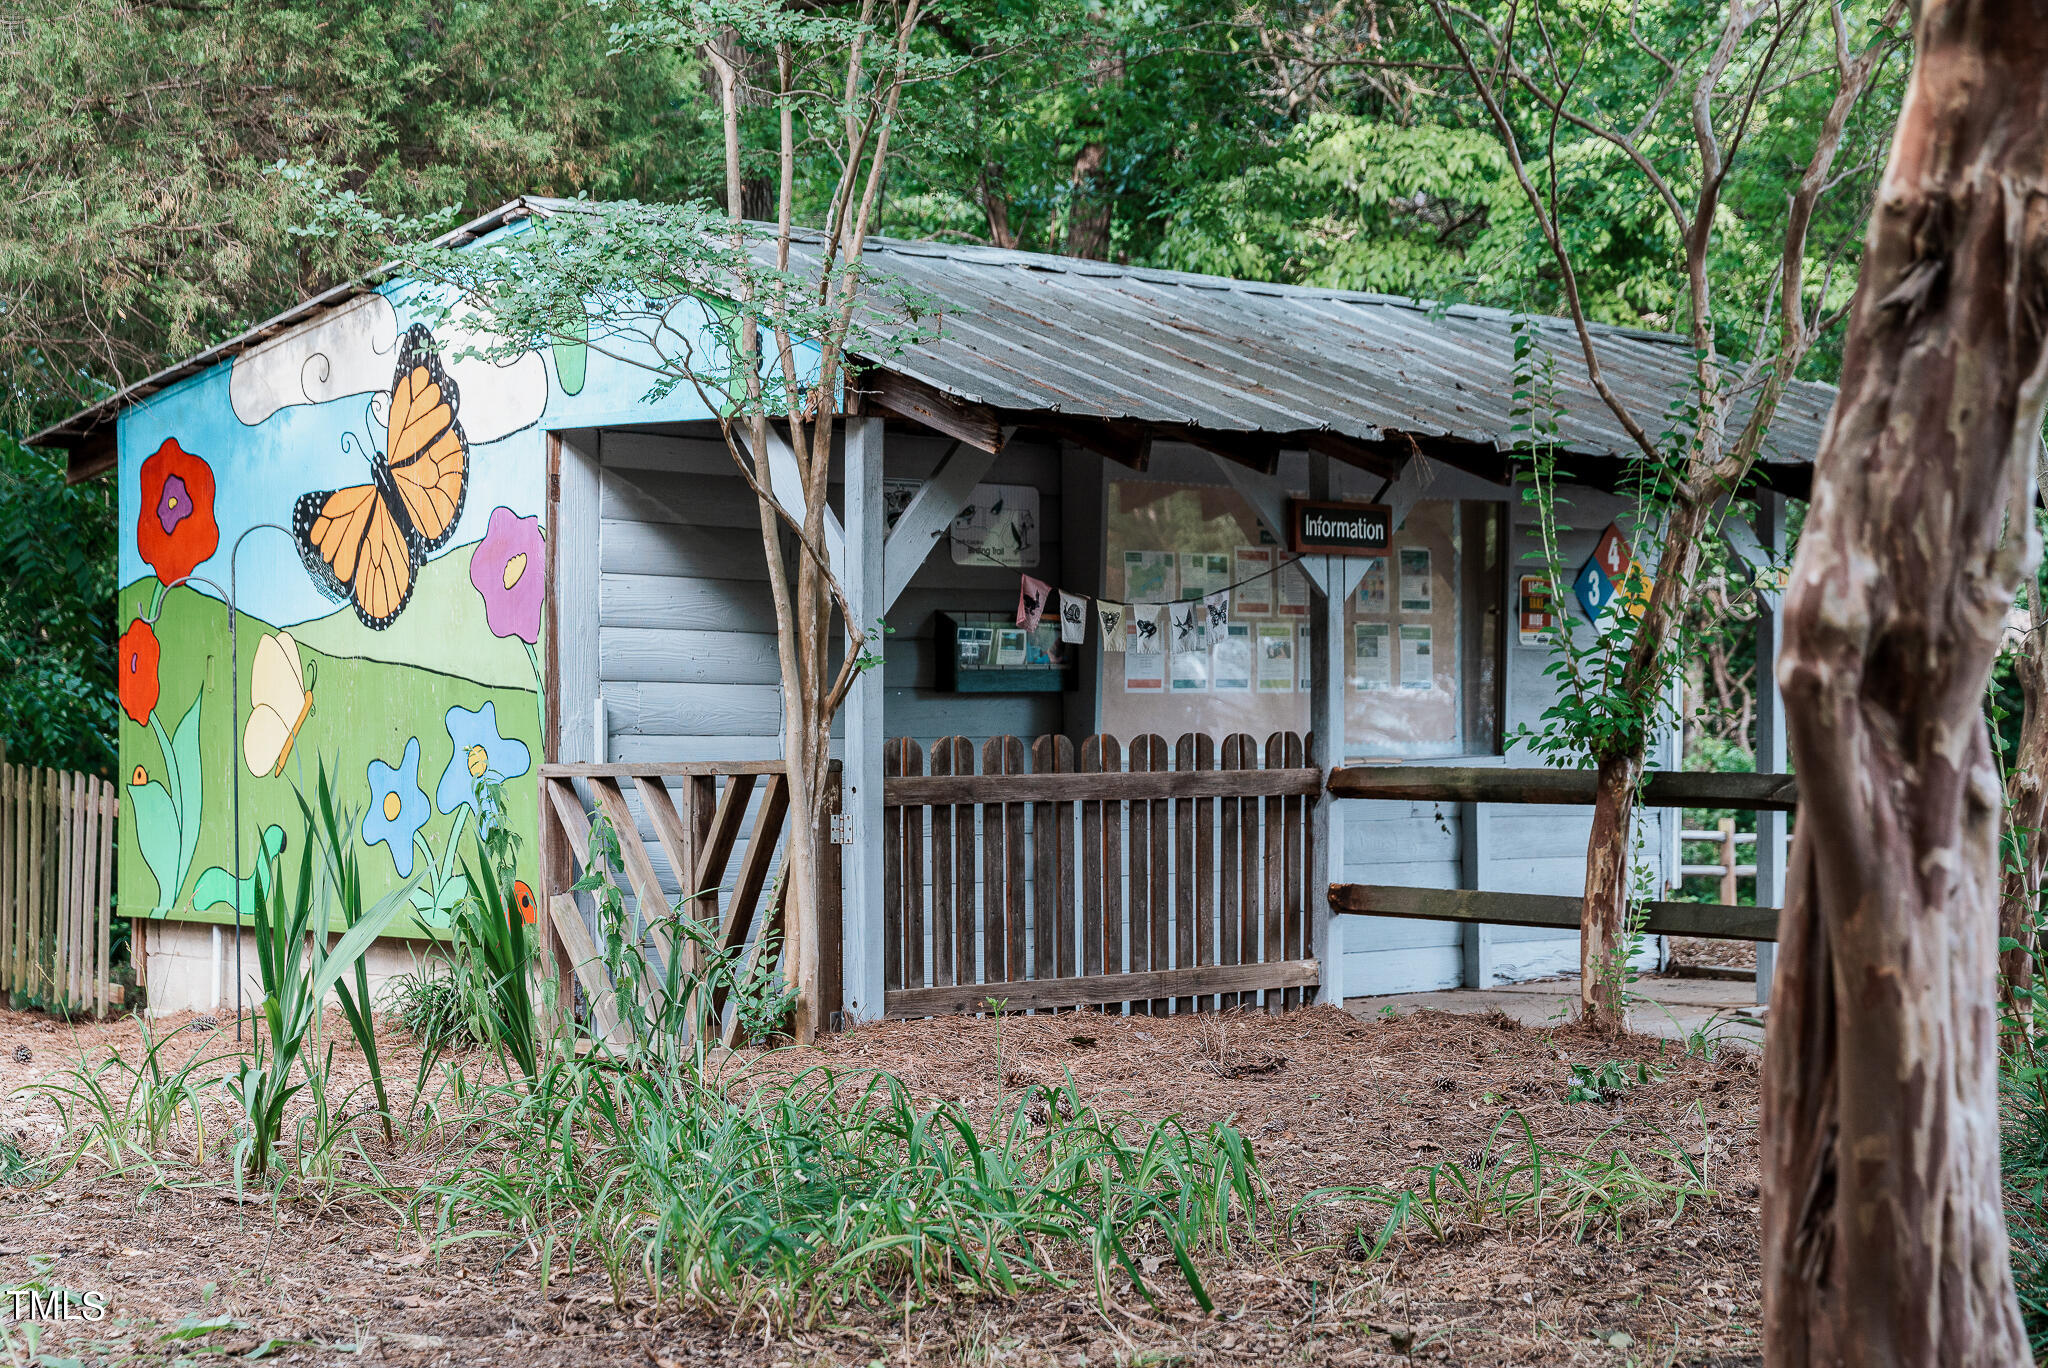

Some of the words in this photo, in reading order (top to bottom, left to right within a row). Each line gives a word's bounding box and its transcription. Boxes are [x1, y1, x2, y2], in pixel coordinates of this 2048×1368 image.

[1305, 513, 1384, 541] Information
[992, 546, 1005, 557] Trail
[1607, 536, 1620, 573] 4
[1588, 569, 1601, 607] 3
